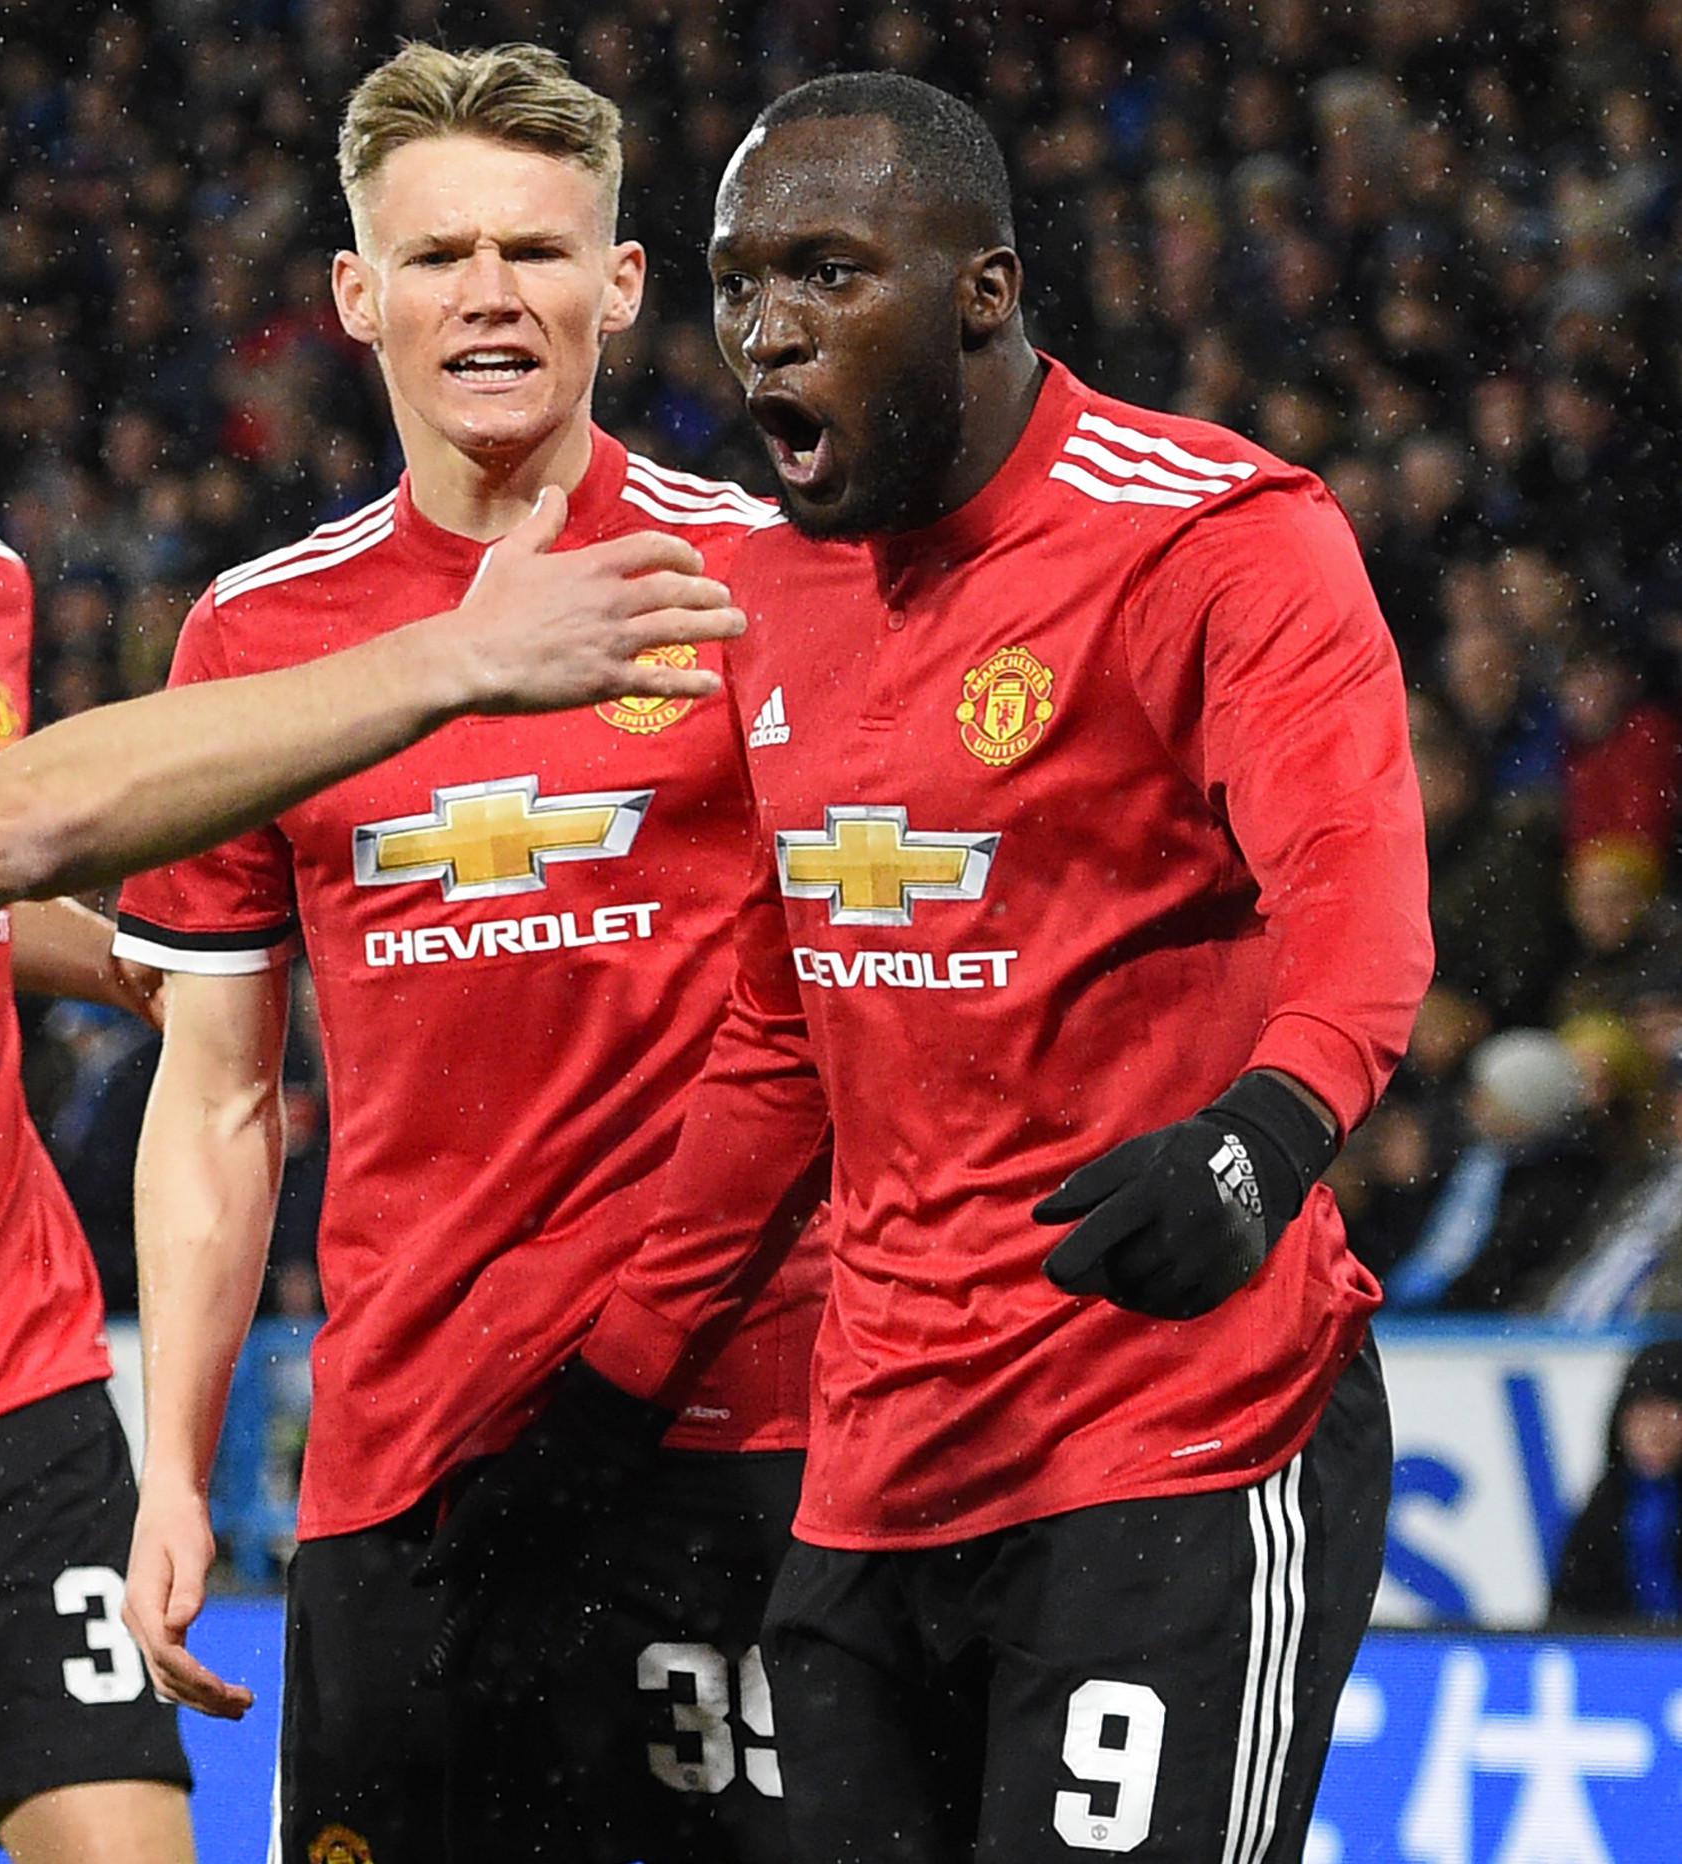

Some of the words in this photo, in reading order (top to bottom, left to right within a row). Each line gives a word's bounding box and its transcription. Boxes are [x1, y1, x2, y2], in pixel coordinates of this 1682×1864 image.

[971, 655, 1047, 693] MANCHESTER
[611, 706, 678, 728] UNITED
[973, 737, 1028, 757] UNITED
[365, 901, 662, 967] CHEVROLET
[1223, 1133, 1263, 1214] adidas
[1053, 1679, 1166, 1853] 9
